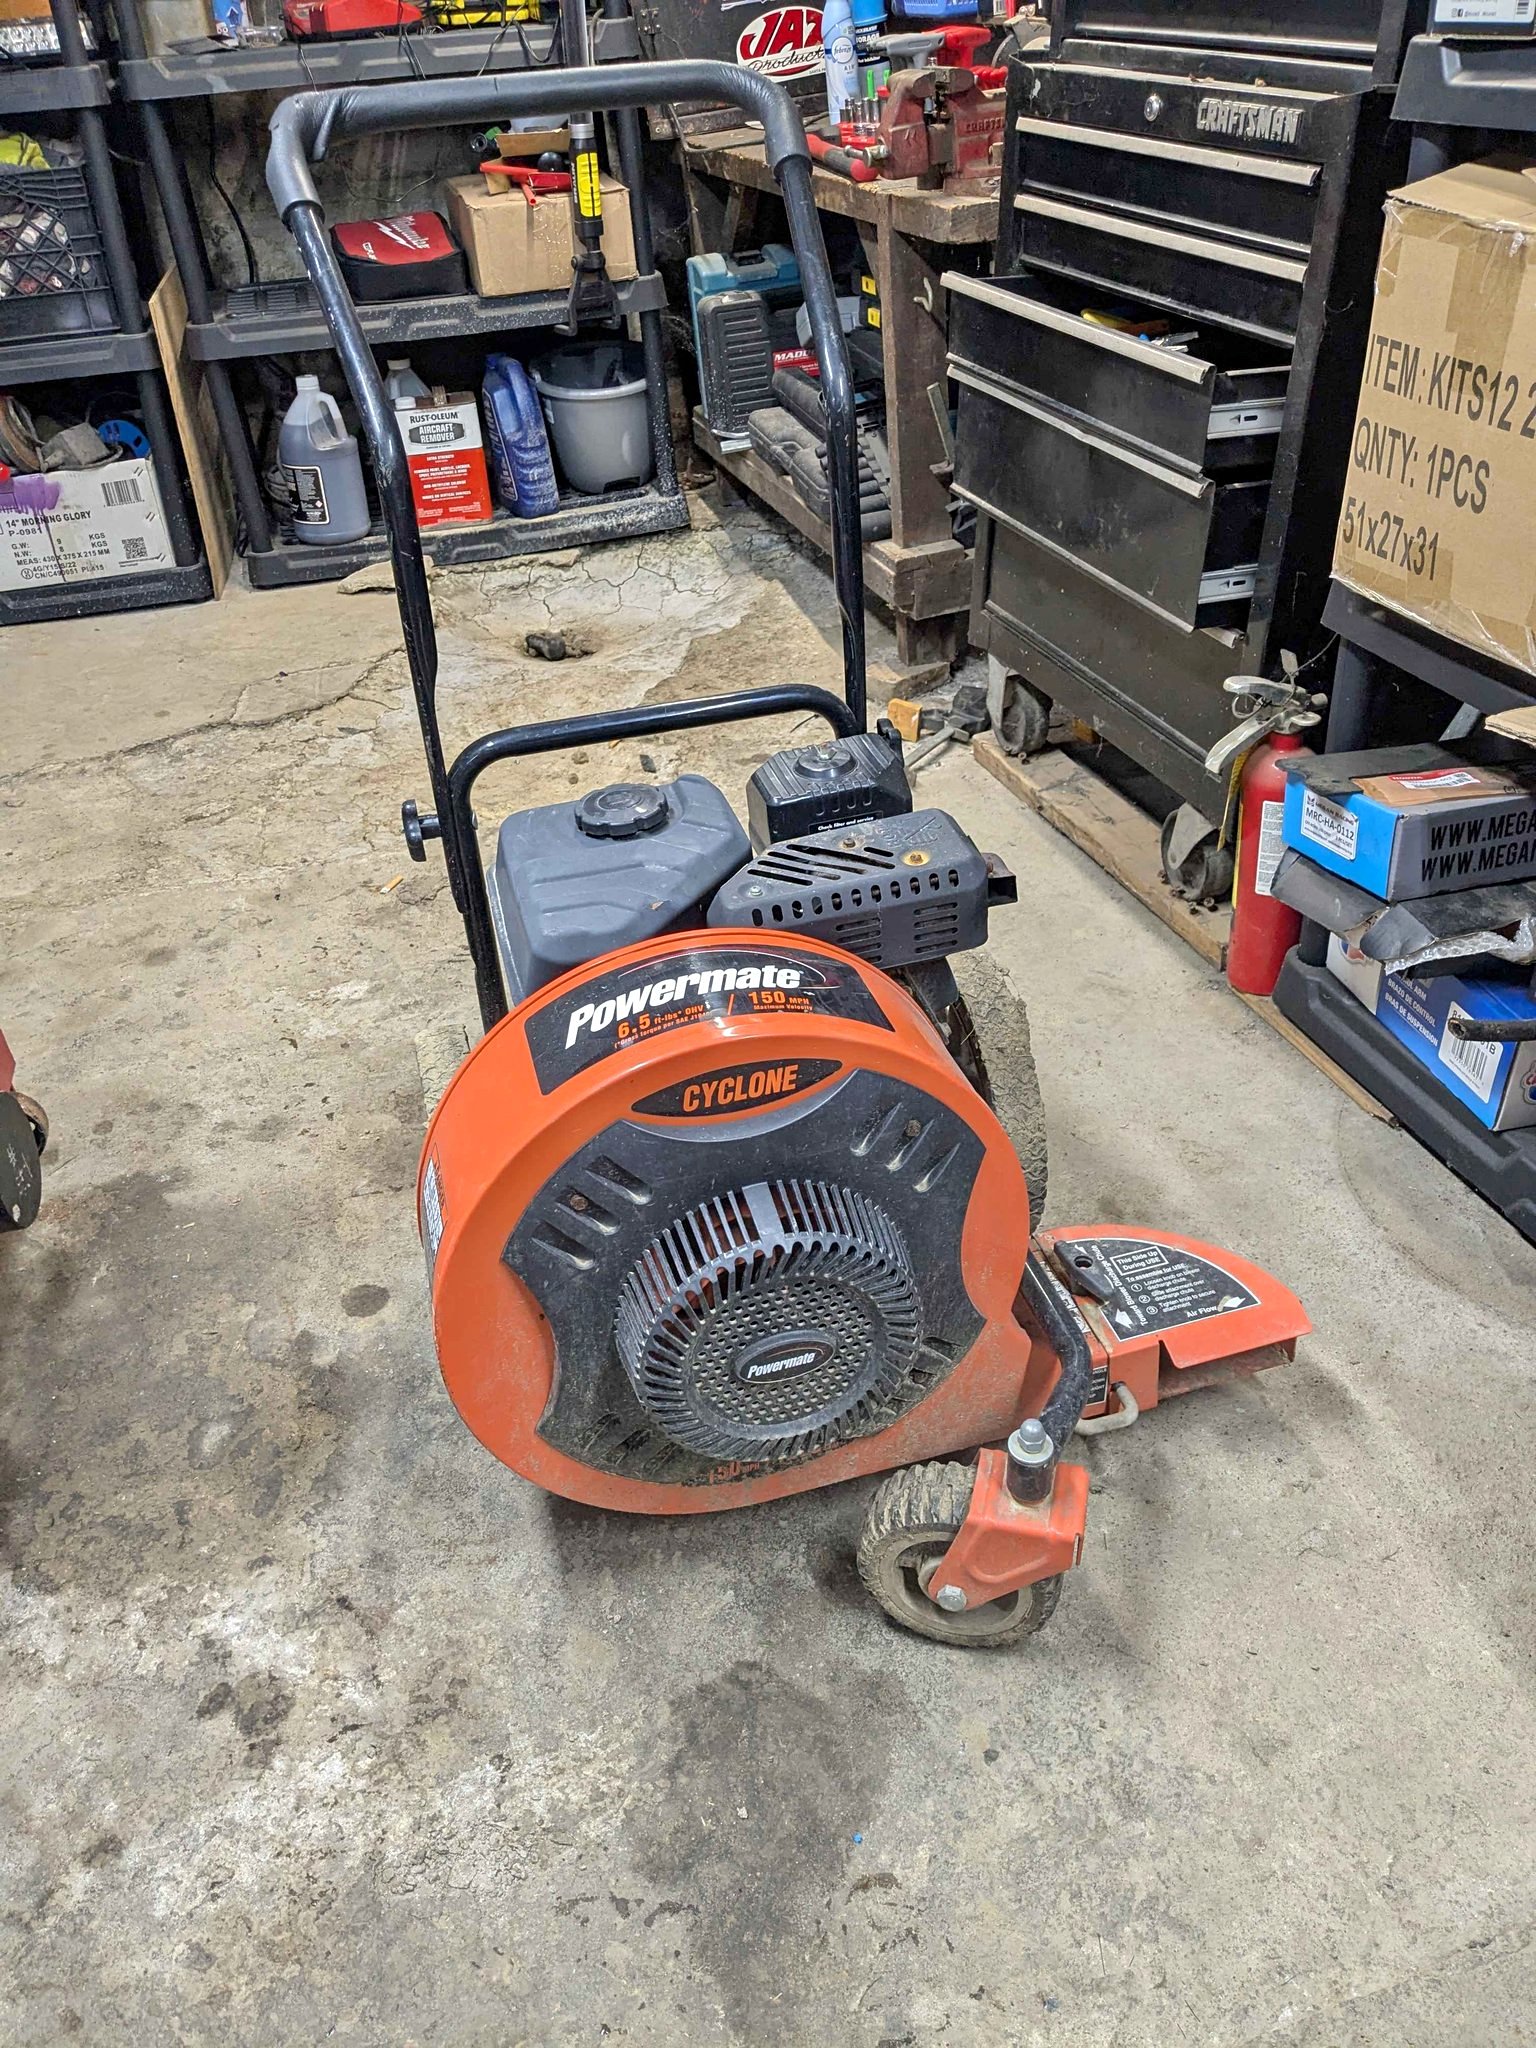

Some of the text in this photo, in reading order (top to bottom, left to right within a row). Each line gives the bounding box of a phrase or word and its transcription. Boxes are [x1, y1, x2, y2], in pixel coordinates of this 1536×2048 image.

[748, 48, 825, 71] Product
[1197, 98, 1304, 144] CRAFTSMAN
[1365, 334, 1425, 404] ITEM:
[1427, 352, 1519, 432] KITS12
[409, 412, 458, 423] RUST-OLEUM
[419, 423, 453, 434] AIRCRAFT
[420, 432, 455, 443] REMOVER
[1353, 417, 1490, 514] QNTY: 1PCS
[6, 510, 92, 528] 14" MORNING GLORY
[8, 528, 43, 537] P-0981
[11, 542, 30, 550] G.W:
[88, 532, 106, 541] KGS
[1342, 496, 1439, 581] 51x27x31
[91, 540, 108, 548] KGS
[16, 557, 41, 566] MEAS:
[63, 553, 77, 561] 375
[84, 550, 97, 558] 215
[818, 823, 833, 831] Check
[1306, 807, 1354, 841] MRC-HA-0112
[748, 991, 786, 1004] 150
[1388, 978, 1404, 997] BRAZO
[1405, 994, 1412, 1005] DE
[1412, 1000, 1436, 1027] CONTROL
[565, 965, 801, 1049] Powermate
[618, 1013, 650, 1038] 6.5
[685, 1004, 704, 1015] OHV
[663, 1021, 674, 1029] per
[676, 1016, 688, 1024] SAE
[1385, 992, 1438, 1047] BRAS DE SUSPENSION
[683, 1064, 798, 1112] CYCLONE
[1117, 1251, 1158, 1265] This Side Up
[1123, 1257, 1161, 1271] During USE
[1091, 1245, 1148, 1326] Toward Blower Discharge Chute
[1186, 1306, 1218, 1318] Air Flow
[747, 1352, 816, 1379] Powermate
